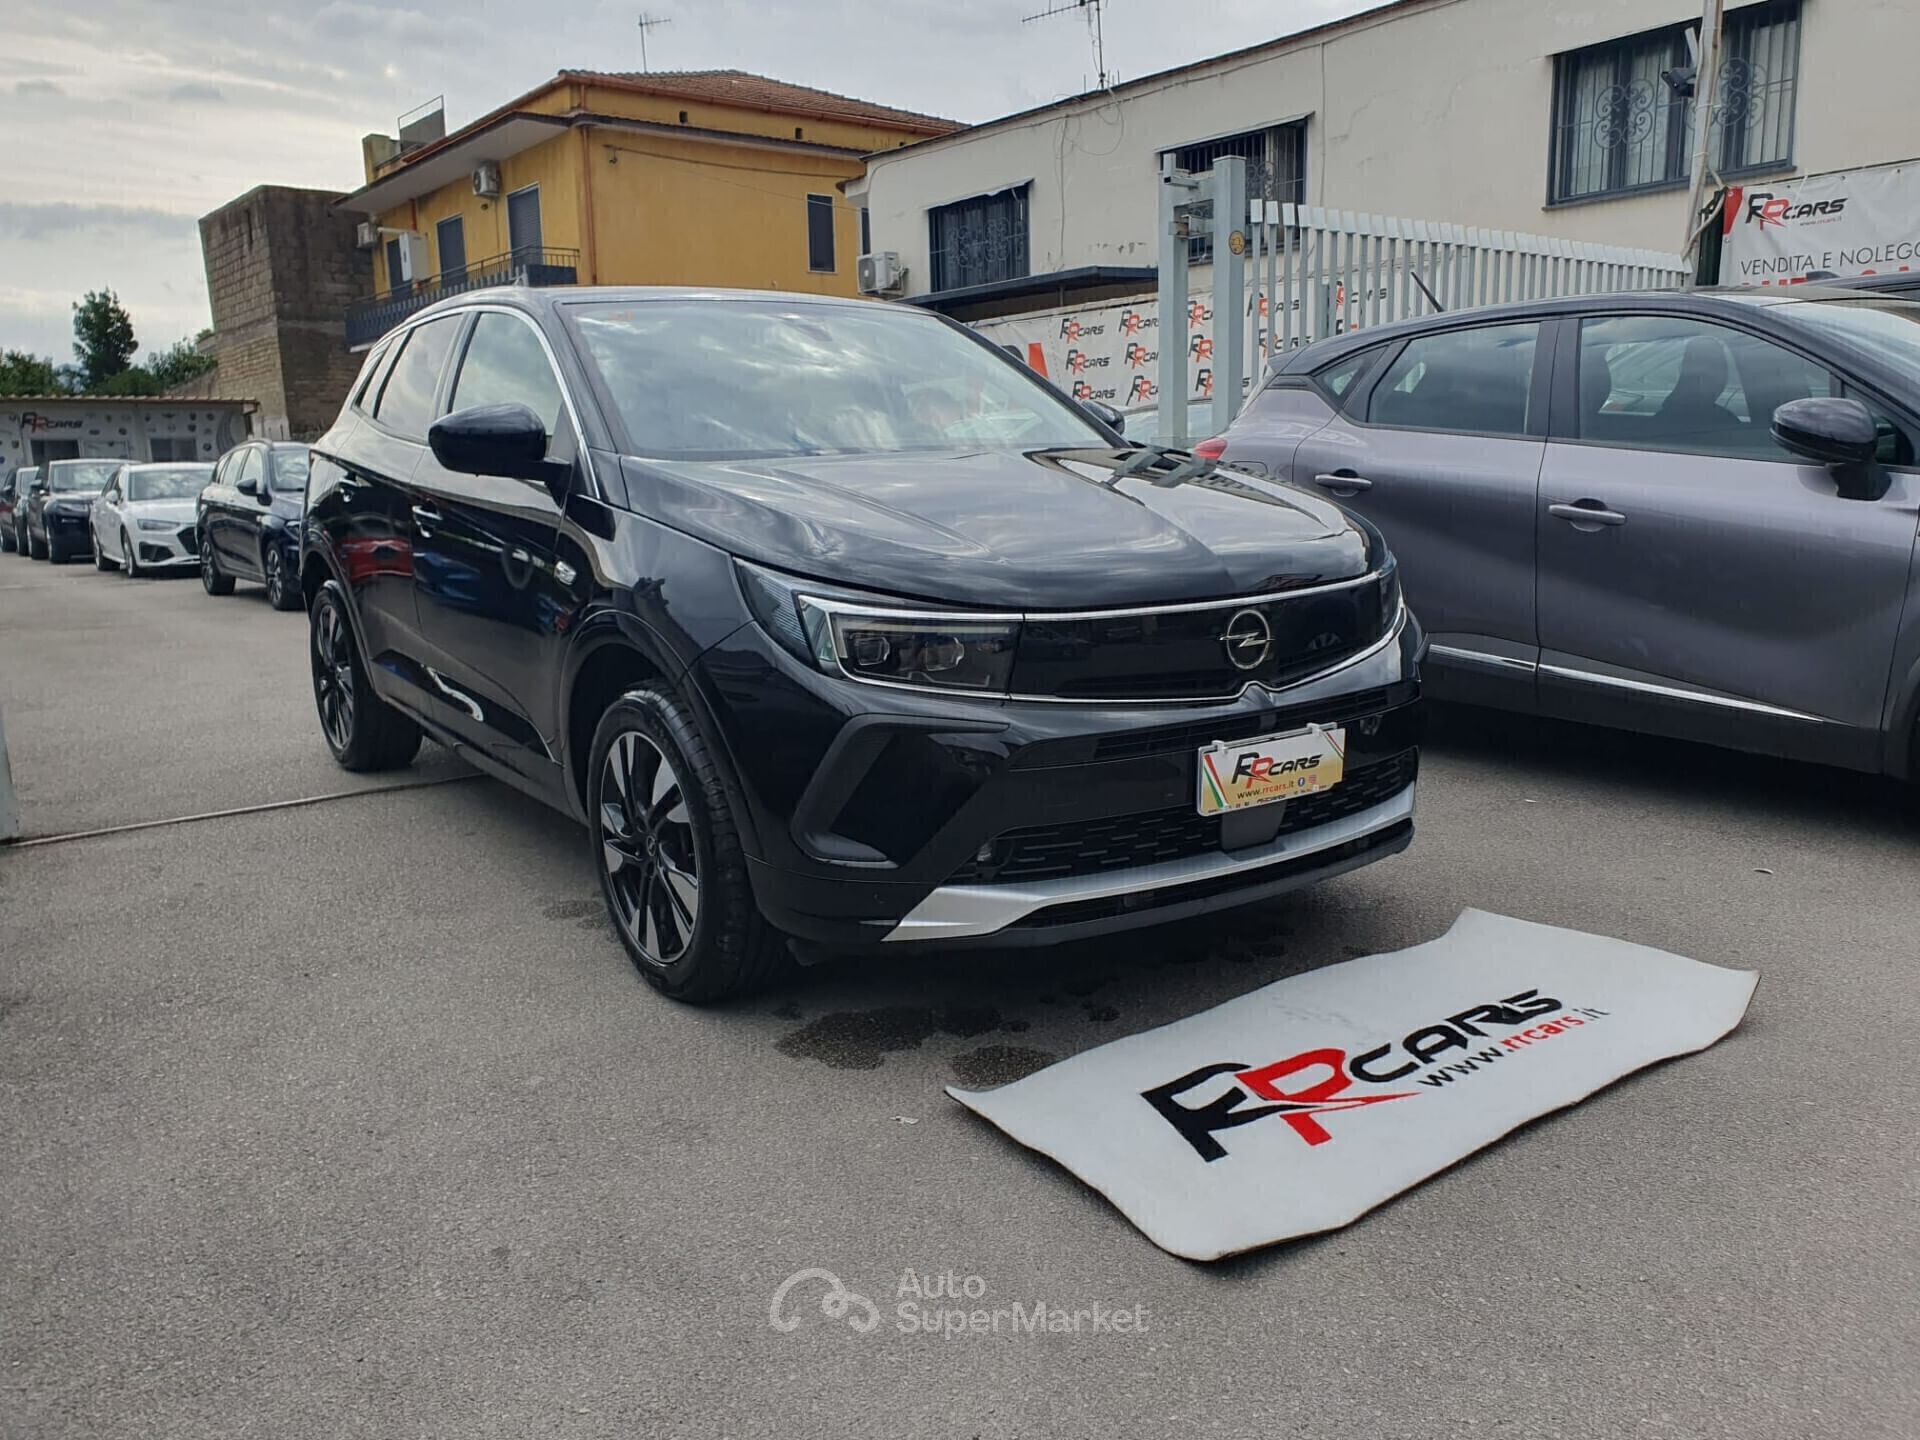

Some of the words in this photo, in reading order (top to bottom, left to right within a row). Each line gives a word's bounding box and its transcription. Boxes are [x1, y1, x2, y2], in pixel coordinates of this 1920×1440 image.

[1741, 254, 1815, 275] VENDITA
[1822, 252, 1832, 269] E
[1236, 780, 1294, 799] www.rrcars.it
[1417, 1007, 1609, 1088] www.rrcars.it
